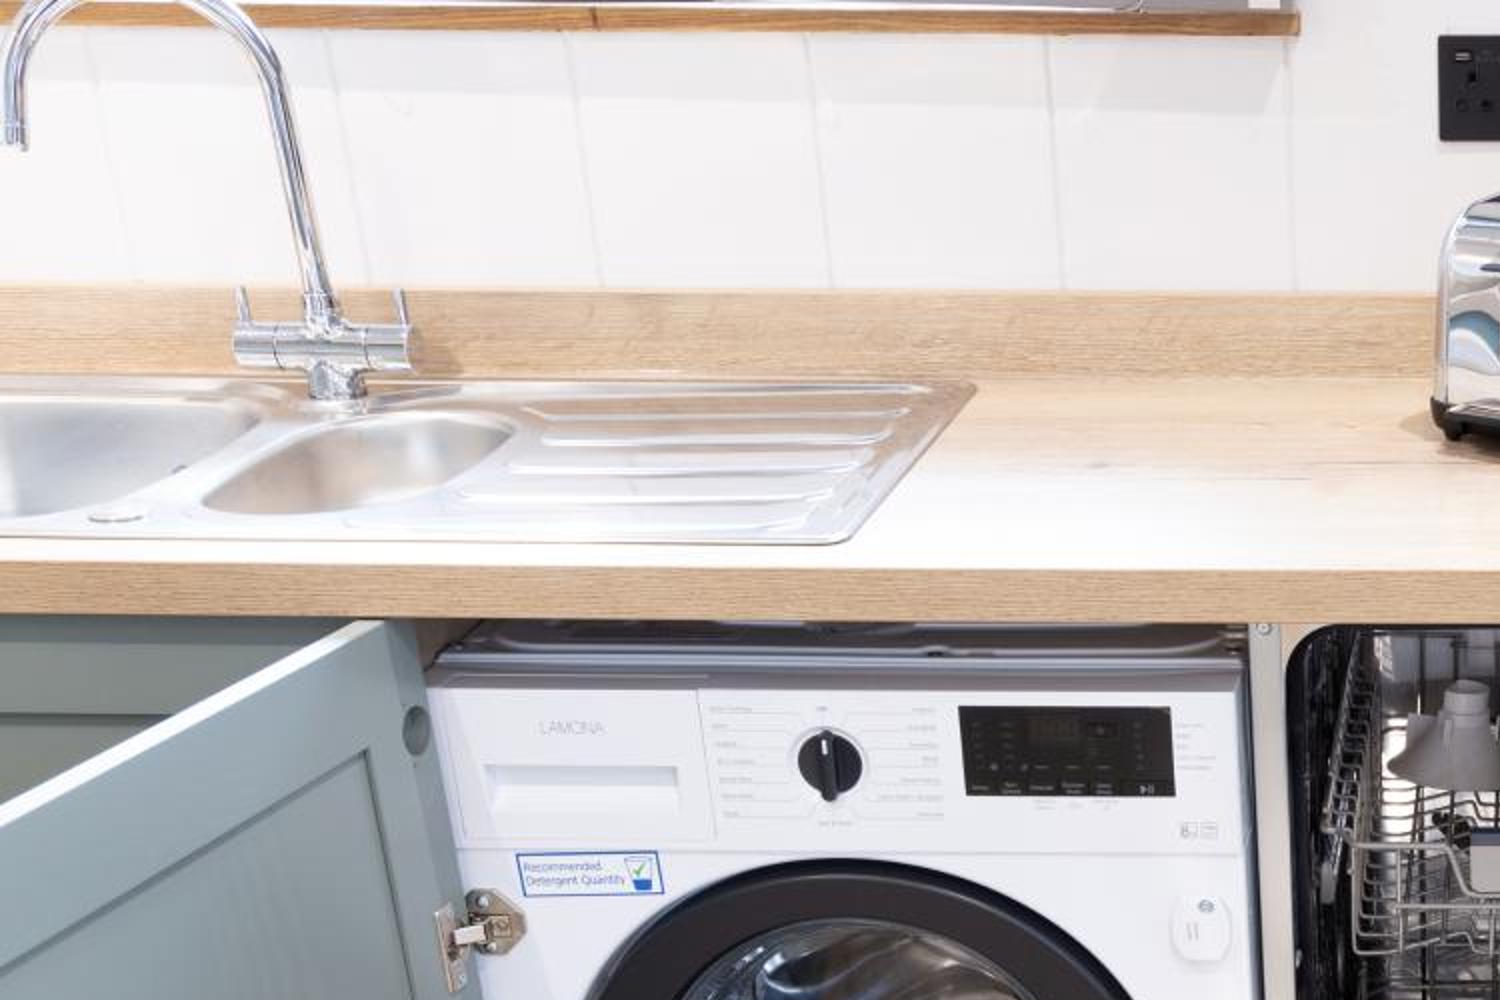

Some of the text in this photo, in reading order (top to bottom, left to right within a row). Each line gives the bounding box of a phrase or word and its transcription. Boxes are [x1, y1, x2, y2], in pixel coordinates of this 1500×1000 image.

[539, 720, 605, 735] LAMONA
[524, 860, 602, 872] Recommended
[526, 873, 625, 888] Detergent Quantity
